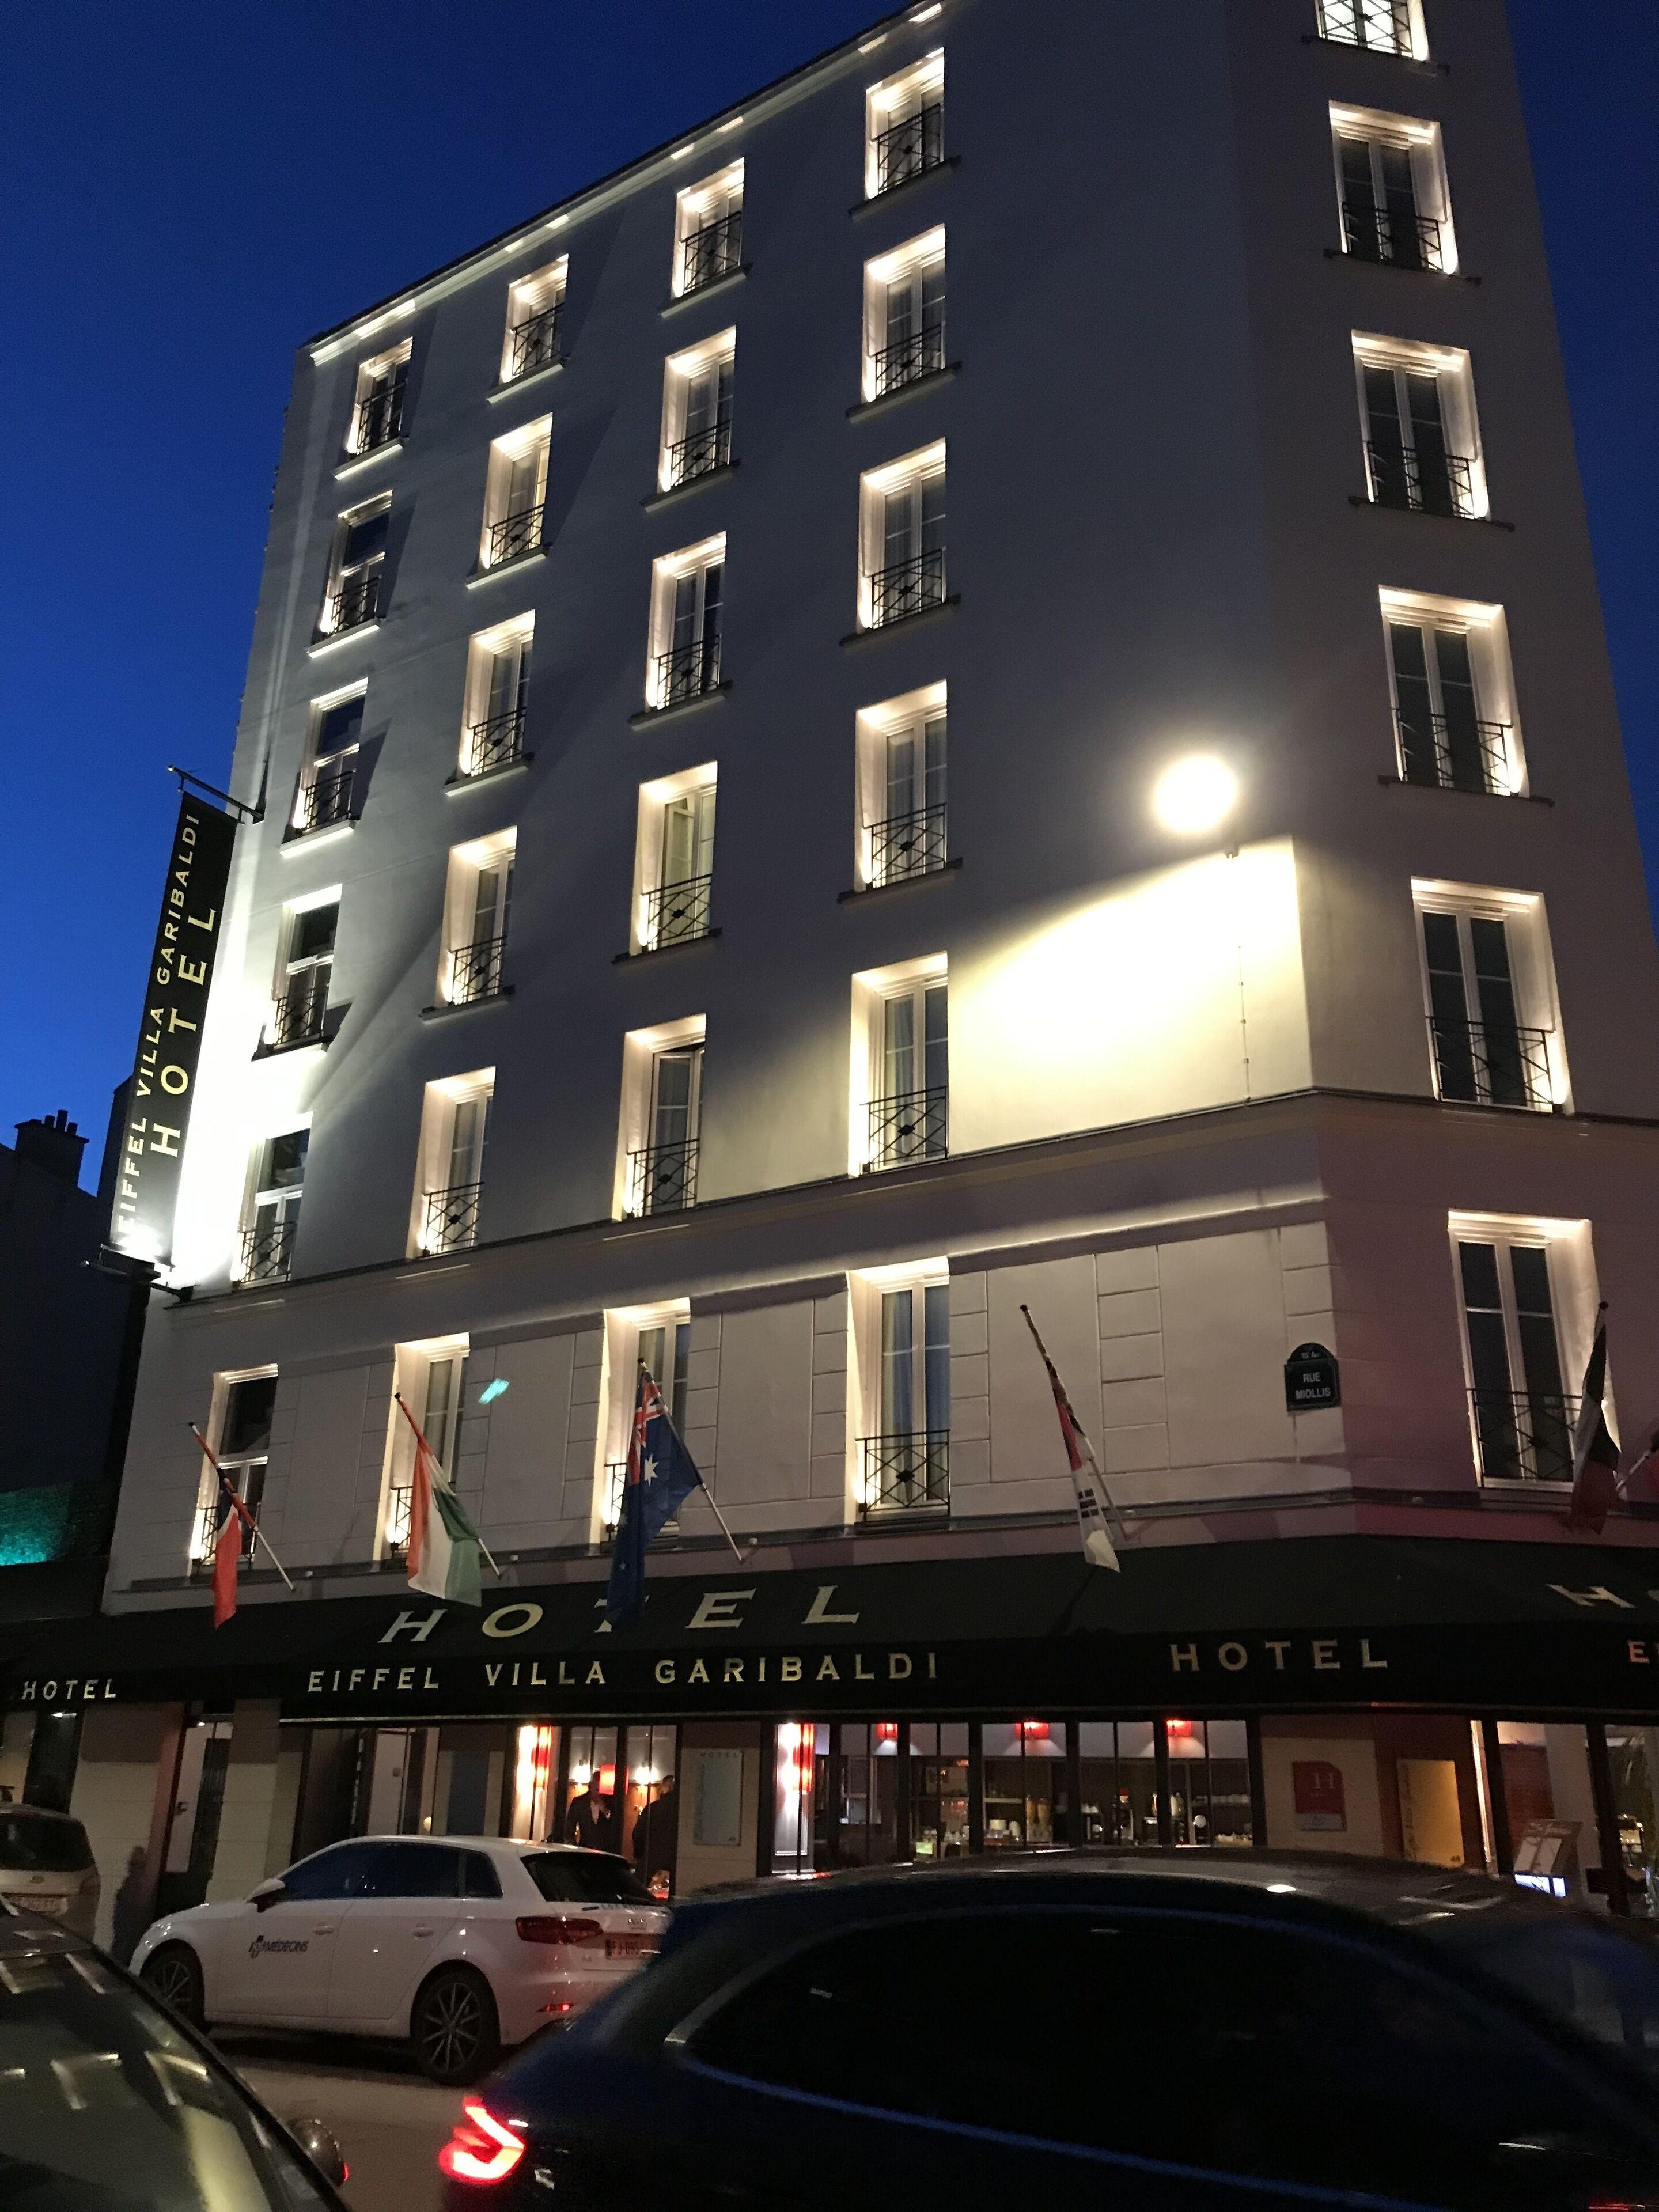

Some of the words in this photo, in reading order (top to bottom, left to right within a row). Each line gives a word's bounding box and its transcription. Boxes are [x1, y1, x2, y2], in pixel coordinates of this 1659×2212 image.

[118, 1118, 147, 1234] EIFFEL
[136, 1007, 165, 1098] VILLA
[157, 815, 200, 986] GARIBALDI
[150, 906, 217, 1158] HOTEL
[1303, 1372, 1321, 1382] RUE
[1296, 1387, 1331, 1400] MIOLLIS
[1547, 1584, 1659, 1608] H
[378, 1585, 861, 1643] HOEL
[1170, 1639, 1388, 1671] HOTEL
[1627, 1639, 1659, 1664] E
[307, 1666, 440, 1692] EIFFEL
[484, 1660, 607, 1687] VILLA
[654, 1653, 937, 1684] GARIBALDI
[21, 1679, 117, 1700] HOTEL
